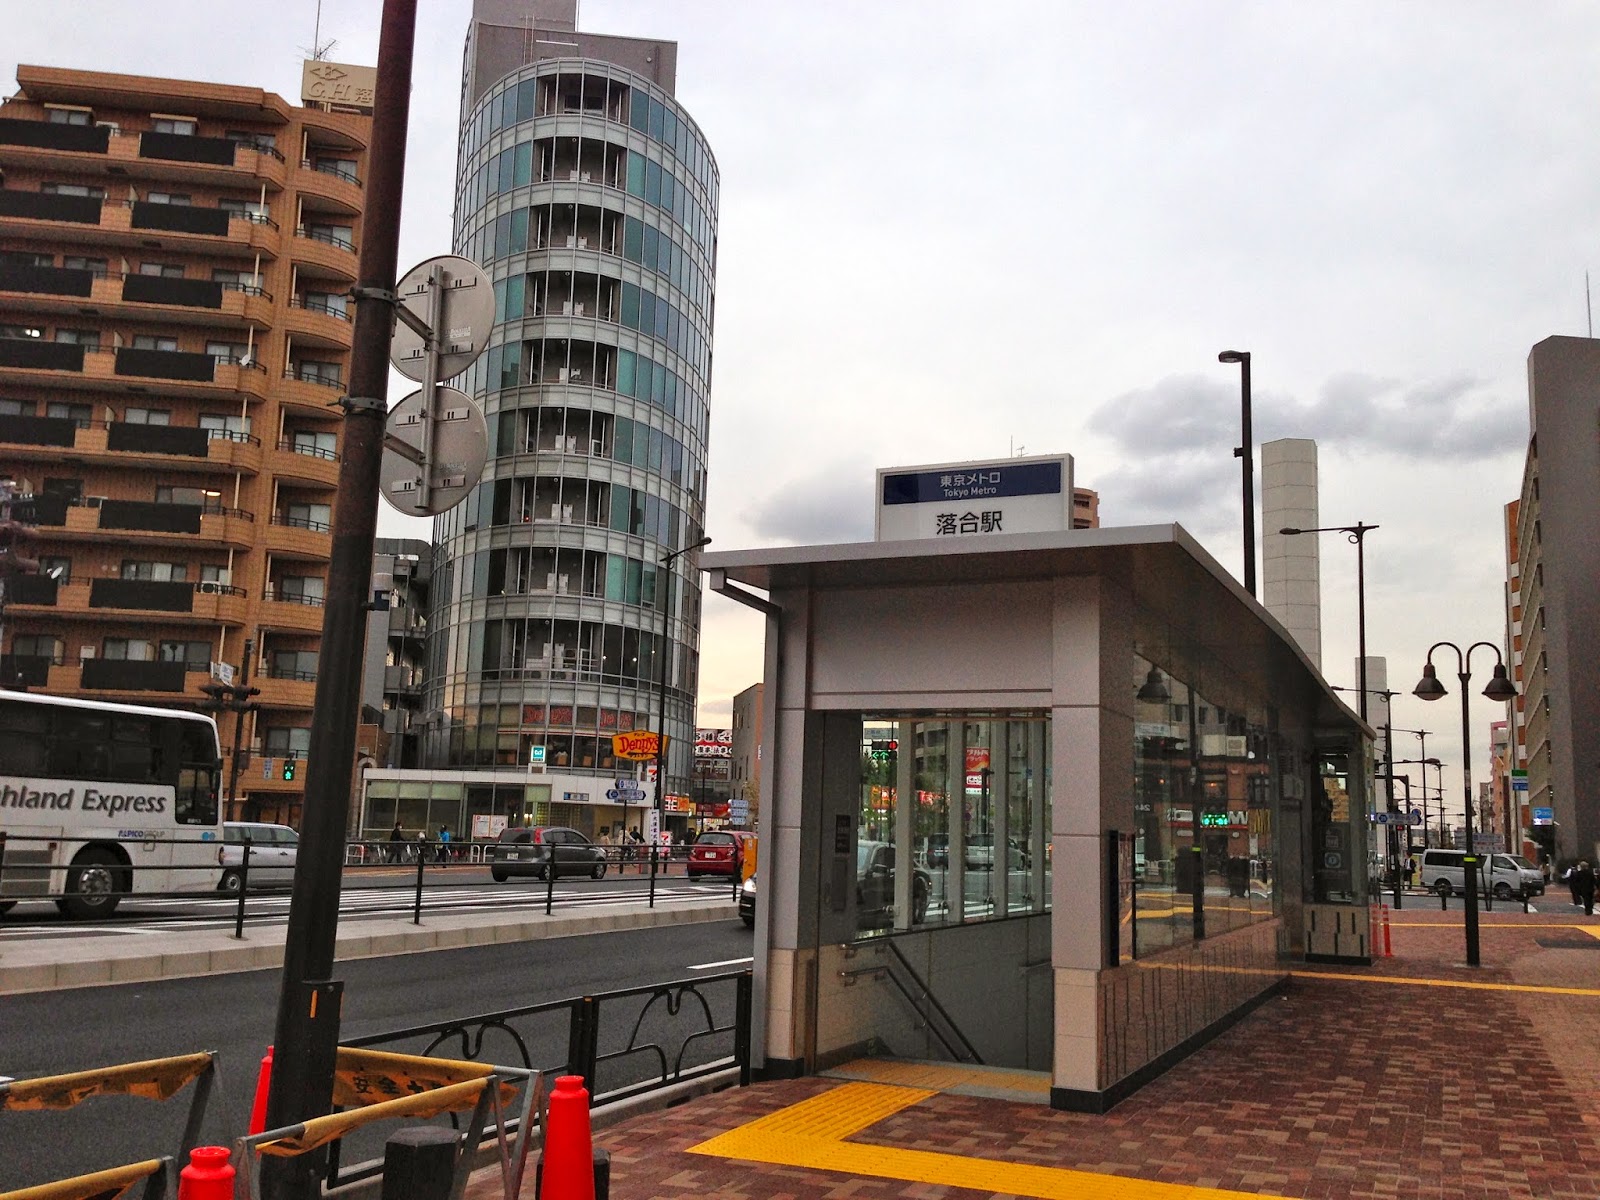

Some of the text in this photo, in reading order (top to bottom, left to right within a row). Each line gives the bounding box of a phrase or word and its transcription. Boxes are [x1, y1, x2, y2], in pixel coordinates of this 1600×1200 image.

[940, 471, 1001, 487] 東京メトロ
[943, 486, 997, 500] Tokyo Metro
[936, 510, 1003, 536] 落合駅
[618, 735, 659, 754] Denny's
[0, 784, 167, 818] hland Express
[118, 829, 144, 838] ALPICO
